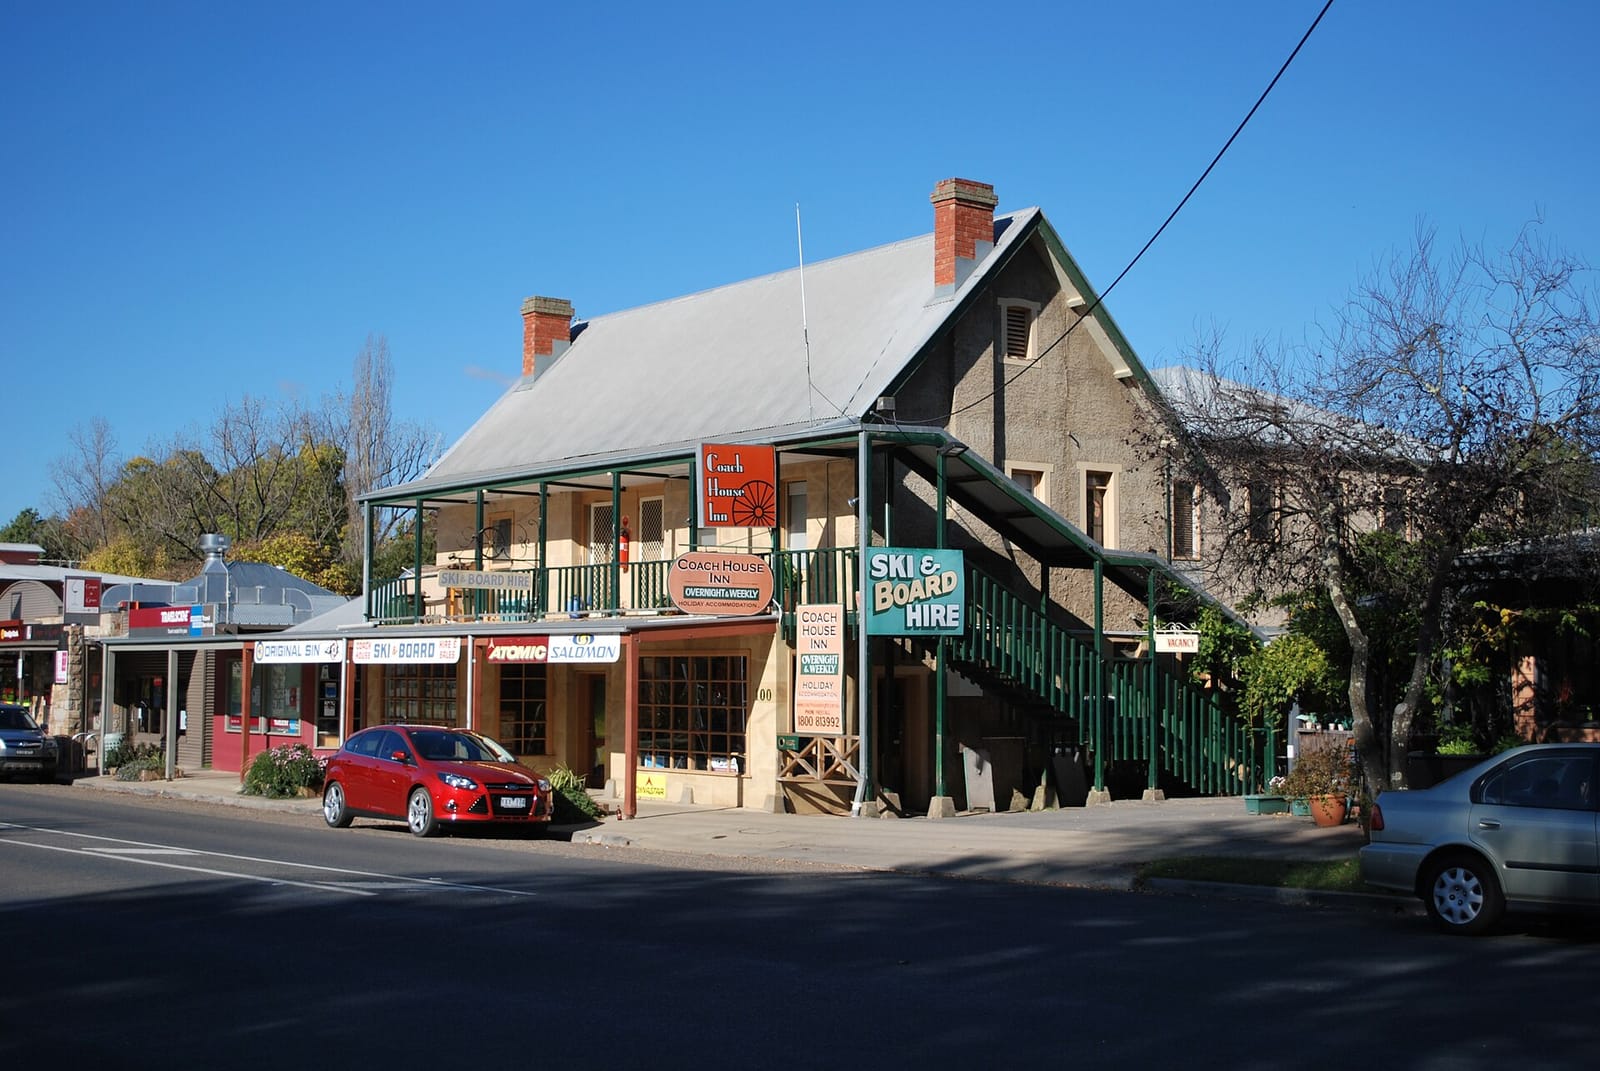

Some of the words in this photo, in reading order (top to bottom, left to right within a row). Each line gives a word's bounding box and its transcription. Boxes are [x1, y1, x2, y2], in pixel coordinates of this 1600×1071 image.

[706, 453, 744, 473] Coach
[707, 477, 745, 497] House
[708, 502, 728, 522] Inn
[677, 558, 720, 571] COACH
[722, 560, 765, 573] HOUSE
[871, 553, 914, 578] SKI
[920, 556, 941, 576] &
[441, 572, 459, 585] SKI
[468, 573, 504, 587] BOARD
[507, 575, 529, 588] HIRE
[709, 573, 730, 583] INN
[873, 570, 959, 615] BOARD
[802, 611, 837, 623] COACH
[905, 603, 961, 629] HIRE
[802, 625, 837, 636] HOUSE
[810, 638, 828, 649] INN
[1168, 638, 1195, 648] VACANCY
[265, 645, 302, 657] ORIGINAL
[305, 644, 320, 657] SIN
[374, 643, 391, 658] SKI
[392, 645, 398, 656] &
[398, 643, 435, 658] BOARD
[488, 645, 548, 660] ATOMIC
[551, 646, 616, 659] SALOMON
[801, 655, 838, 665] OVERNIGHT
[802, 681, 834, 690] HOLIDAY
[798, 715, 814, 727] 1800
[815, 716, 840, 728] 813992
